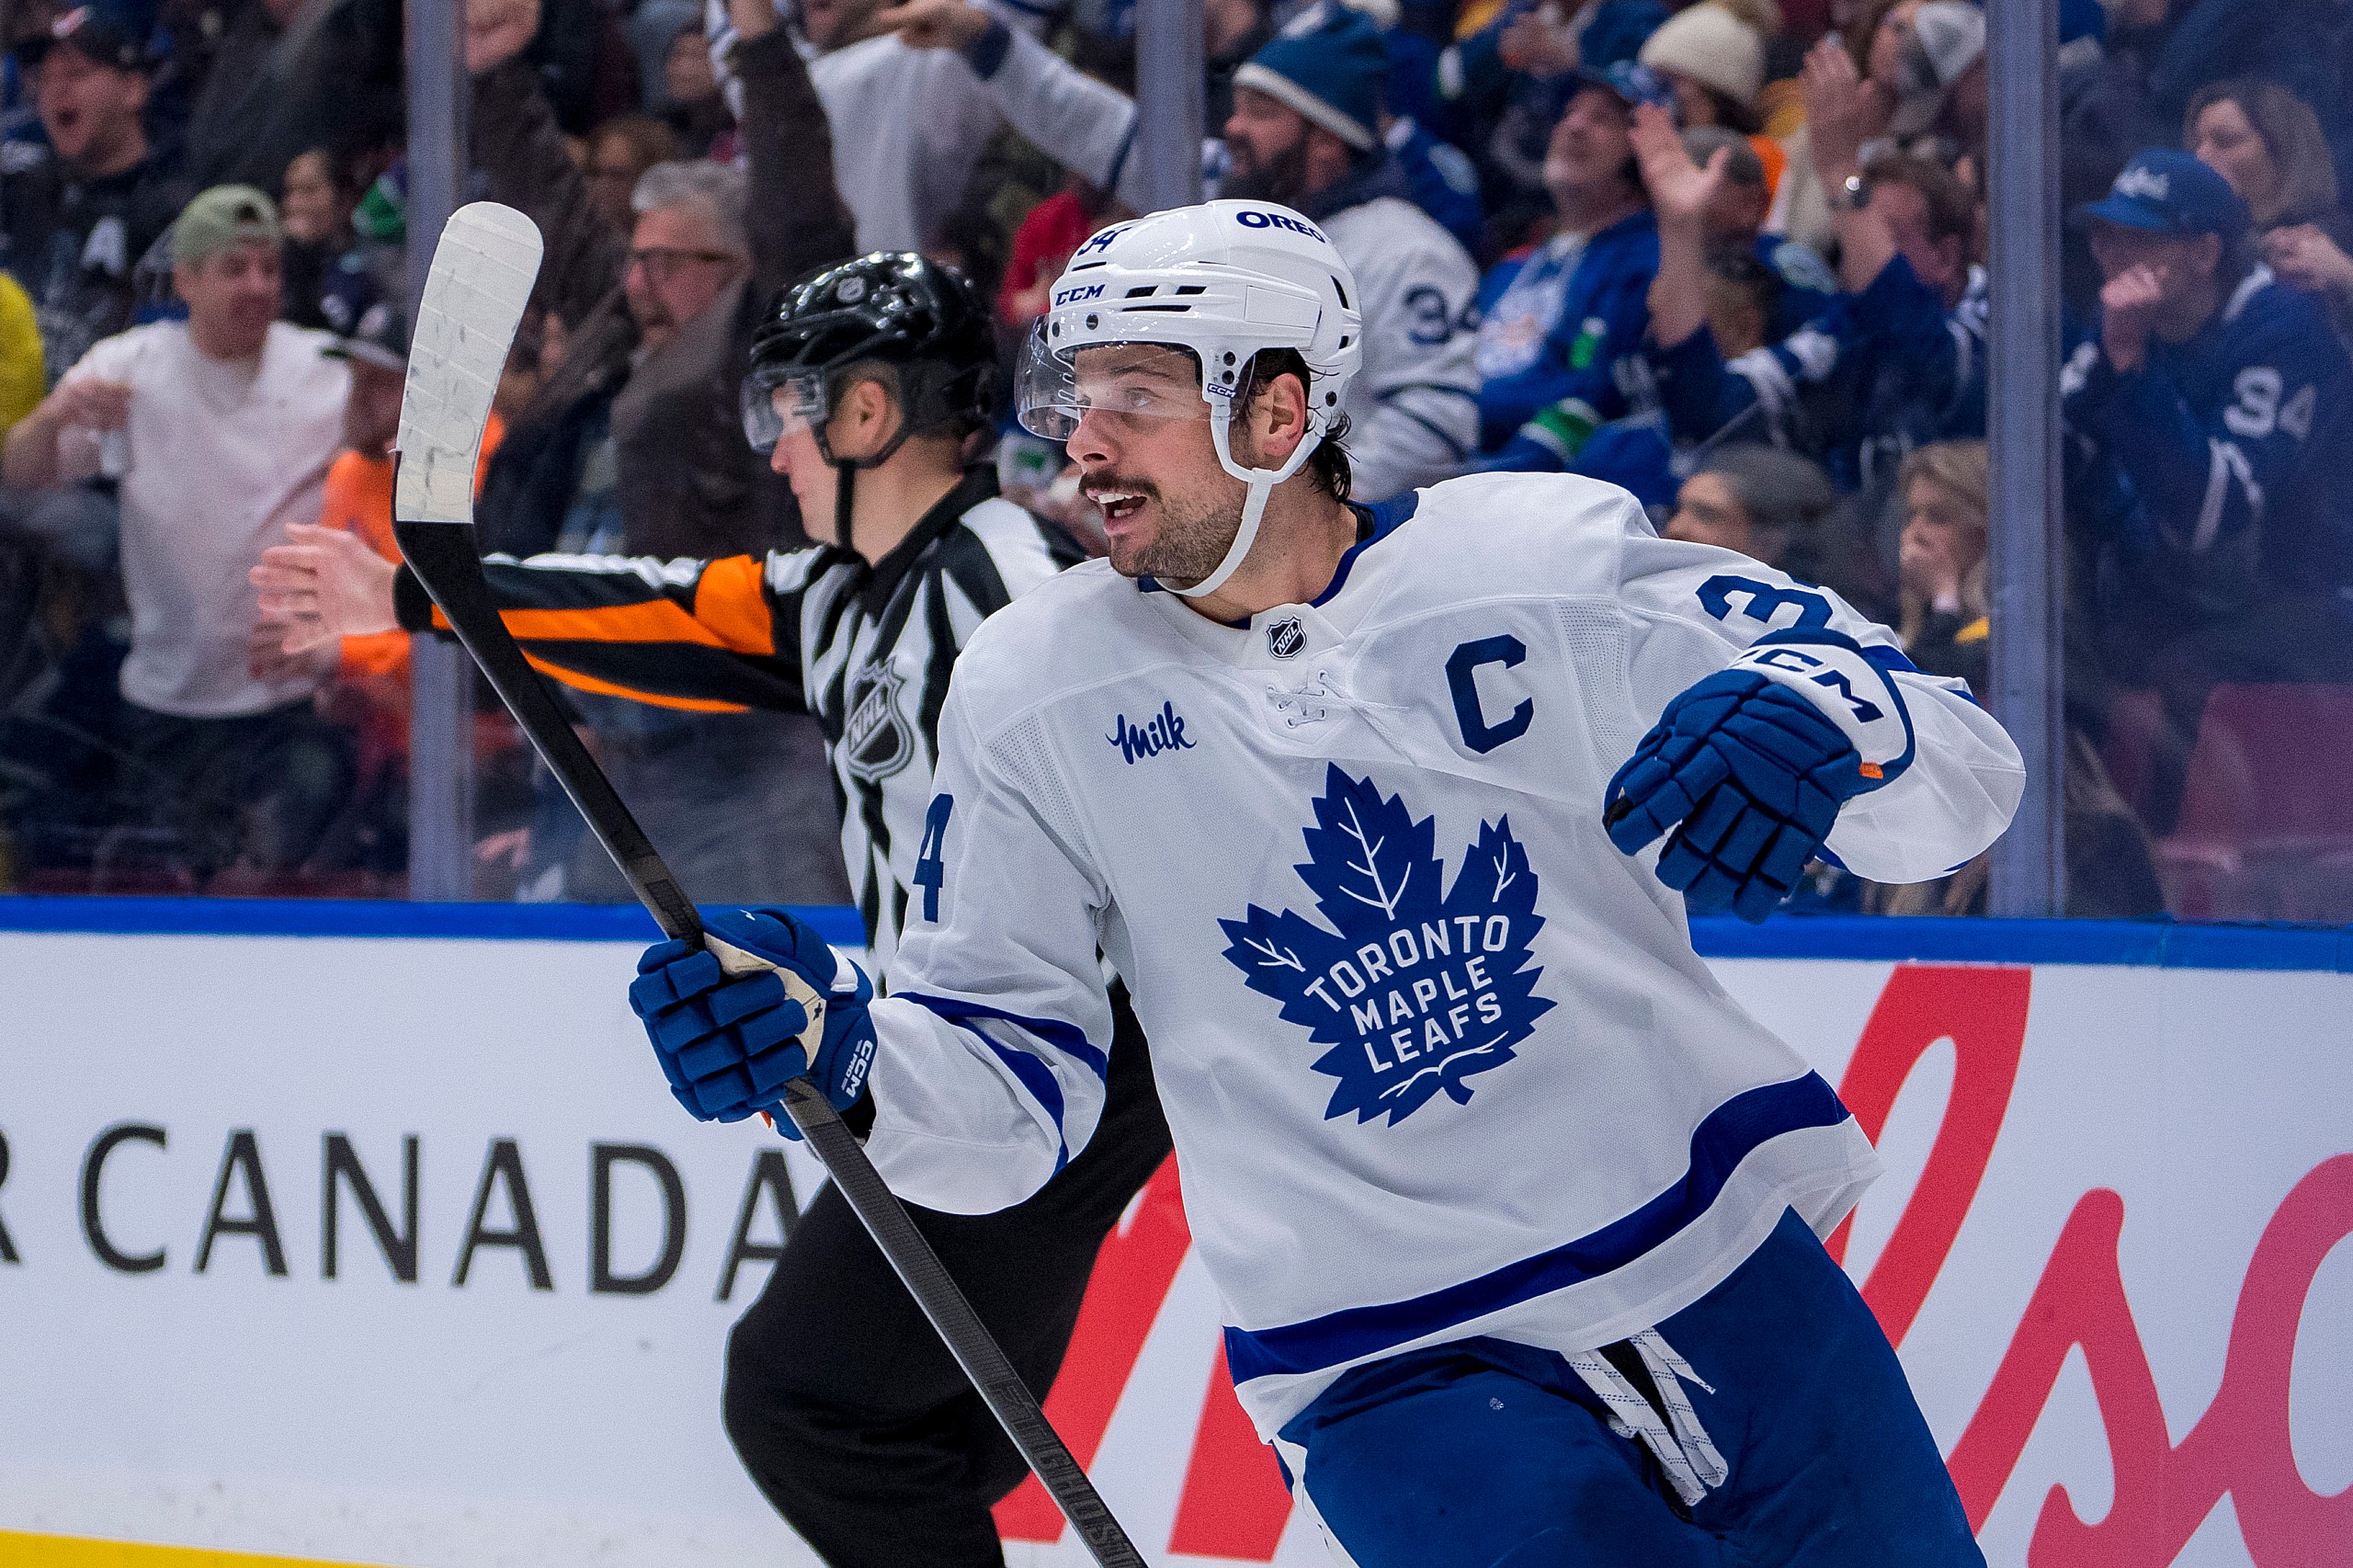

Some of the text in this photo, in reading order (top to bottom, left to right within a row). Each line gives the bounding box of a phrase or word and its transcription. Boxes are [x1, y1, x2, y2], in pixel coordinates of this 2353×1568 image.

[1236, 210, 1325, 244] OREO
[1055, 284, 1106, 306] CCM
[1208, 384, 1236, 398] CCM
[1696, 575, 1834, 629] 3
[1277, 626, 1298, 653] NHL
[1445, 634, 1534, 754] C
[1731, 648, 1884, 723] CM
[849, 689, 888, 752] NHL
[1105, 700, 1197, 765] Milk
[913, 793, 954, 923] 4
[1303, 915, 1510, 1012] TORONTO
[1349, 955, 1493, 1036] MAPLE
[1364, 992, 1502, 1074] LEAFS
[846, 1040, 873, 1098] CCM
[80, 1120, 801, 1303] CANADA
